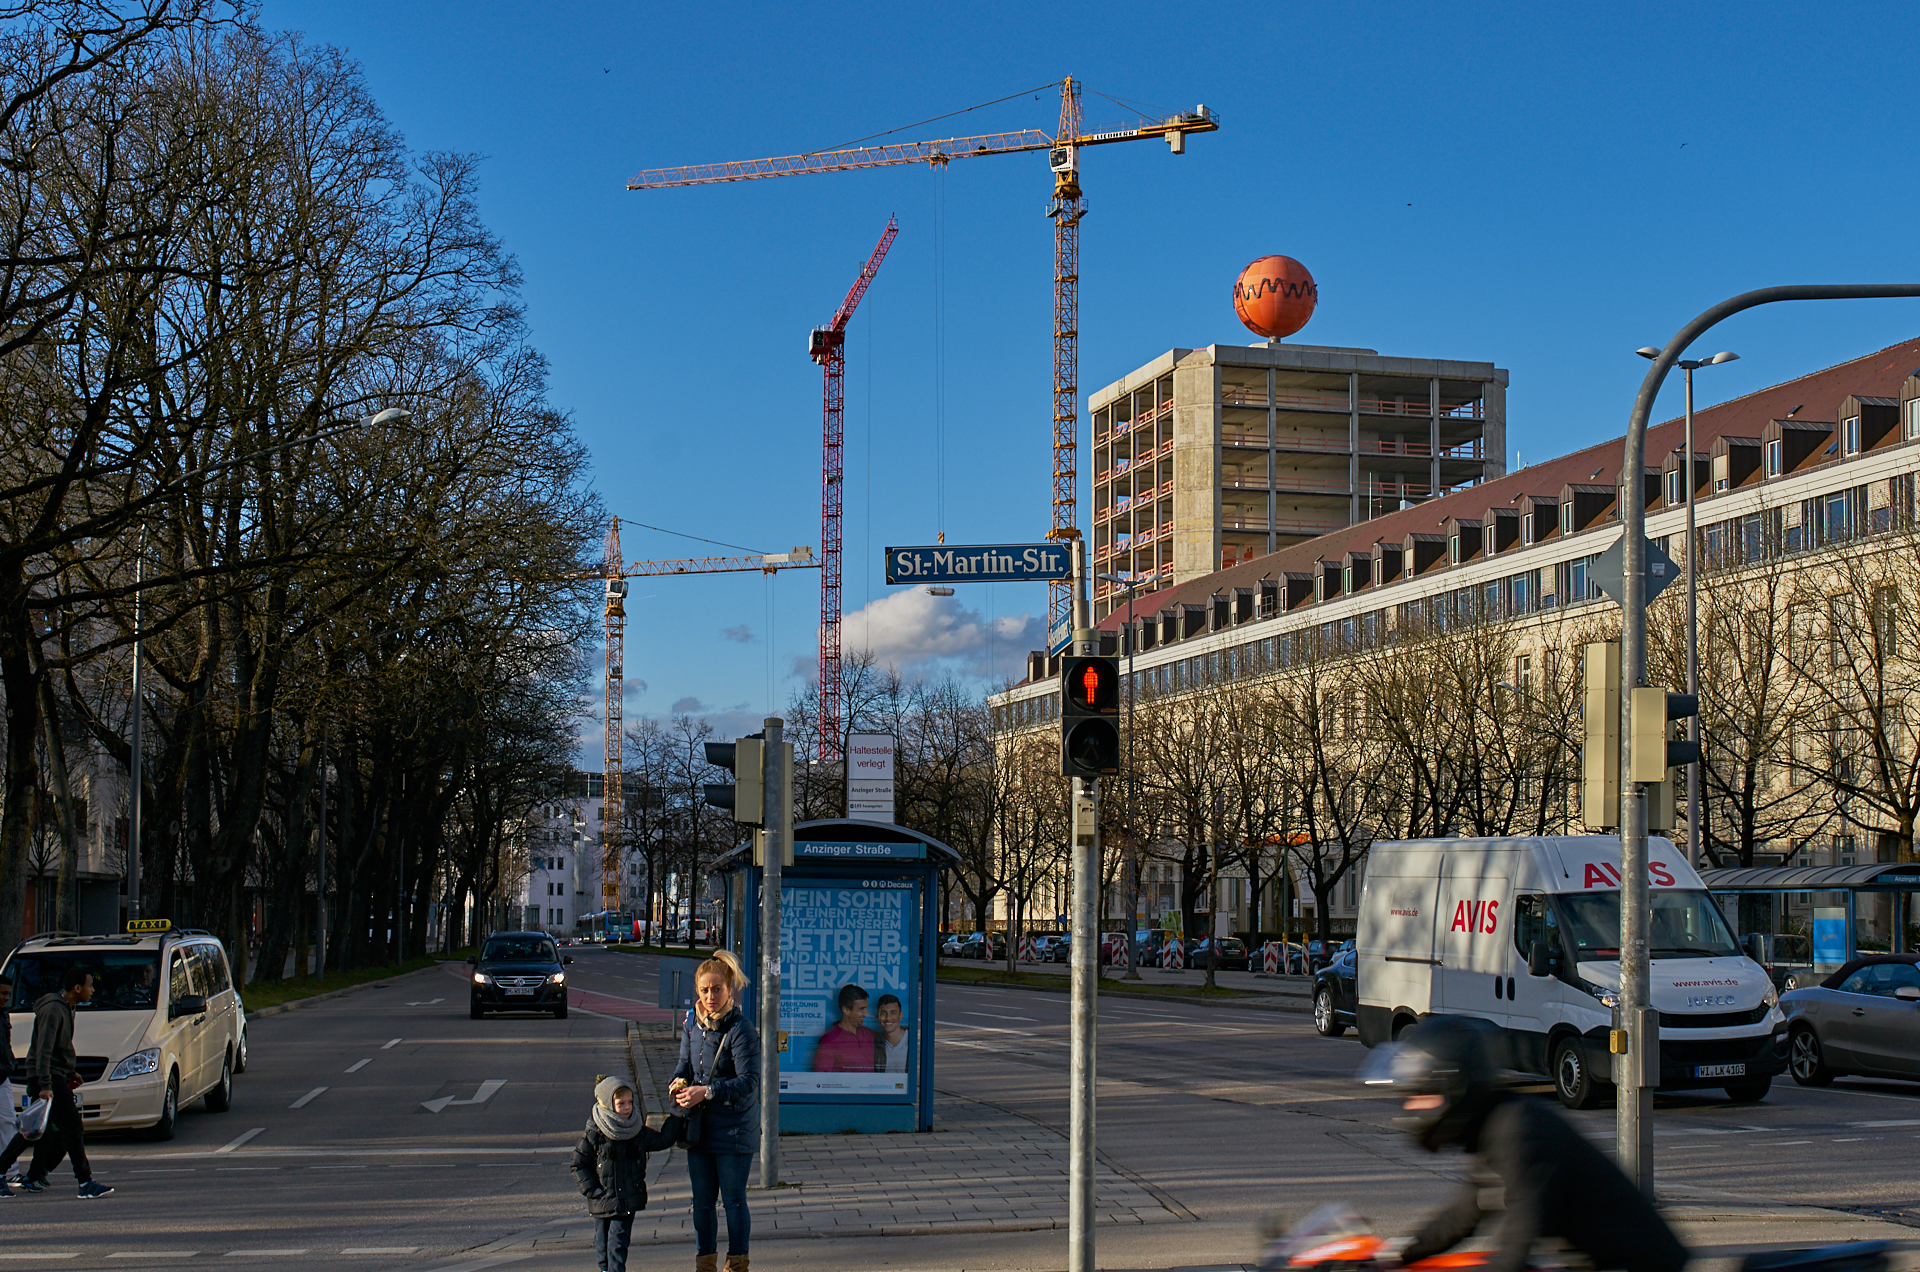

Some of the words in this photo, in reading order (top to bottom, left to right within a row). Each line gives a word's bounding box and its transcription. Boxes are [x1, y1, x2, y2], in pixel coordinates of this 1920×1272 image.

[897, 548, 1064, 576] St.-Martin-Str.
[850, 745, 893, 755] Haltestelle
[857, 759, 886, 769] verlegt
[804, 844, 851, 855] Anzinger
[855, 844, 891, 854] Straße
[837, 891, 901, 908] SOHN
[805, 908, 846, 919] EINEN
[850, 909, 901, 919] FESTEN
[1390, 907, 1418, 917] www.avis.de
[1451, 900, 1499, 934] AVIS
[134, 920, 162, 929] TAXI
[817, 918, 833, 928] IN
[837, 919, 901, 929] UNSEREM
[780, 928, 908, 953] BETRIEB.
[815, 951, 831, 964] IN
[836, 952, 900, 965] MEINEM
[780, 964, 907, 990] HERZEN.
[1672, 978, 1739, 987] www.avis.de
[1686, 995, 1735, 1007] IVECO
[1700, 1066, 1710, 1076] WI
[1715, 1066, 1725, 1075] LK
[1726, 1065, 1745, 1074] 4103
